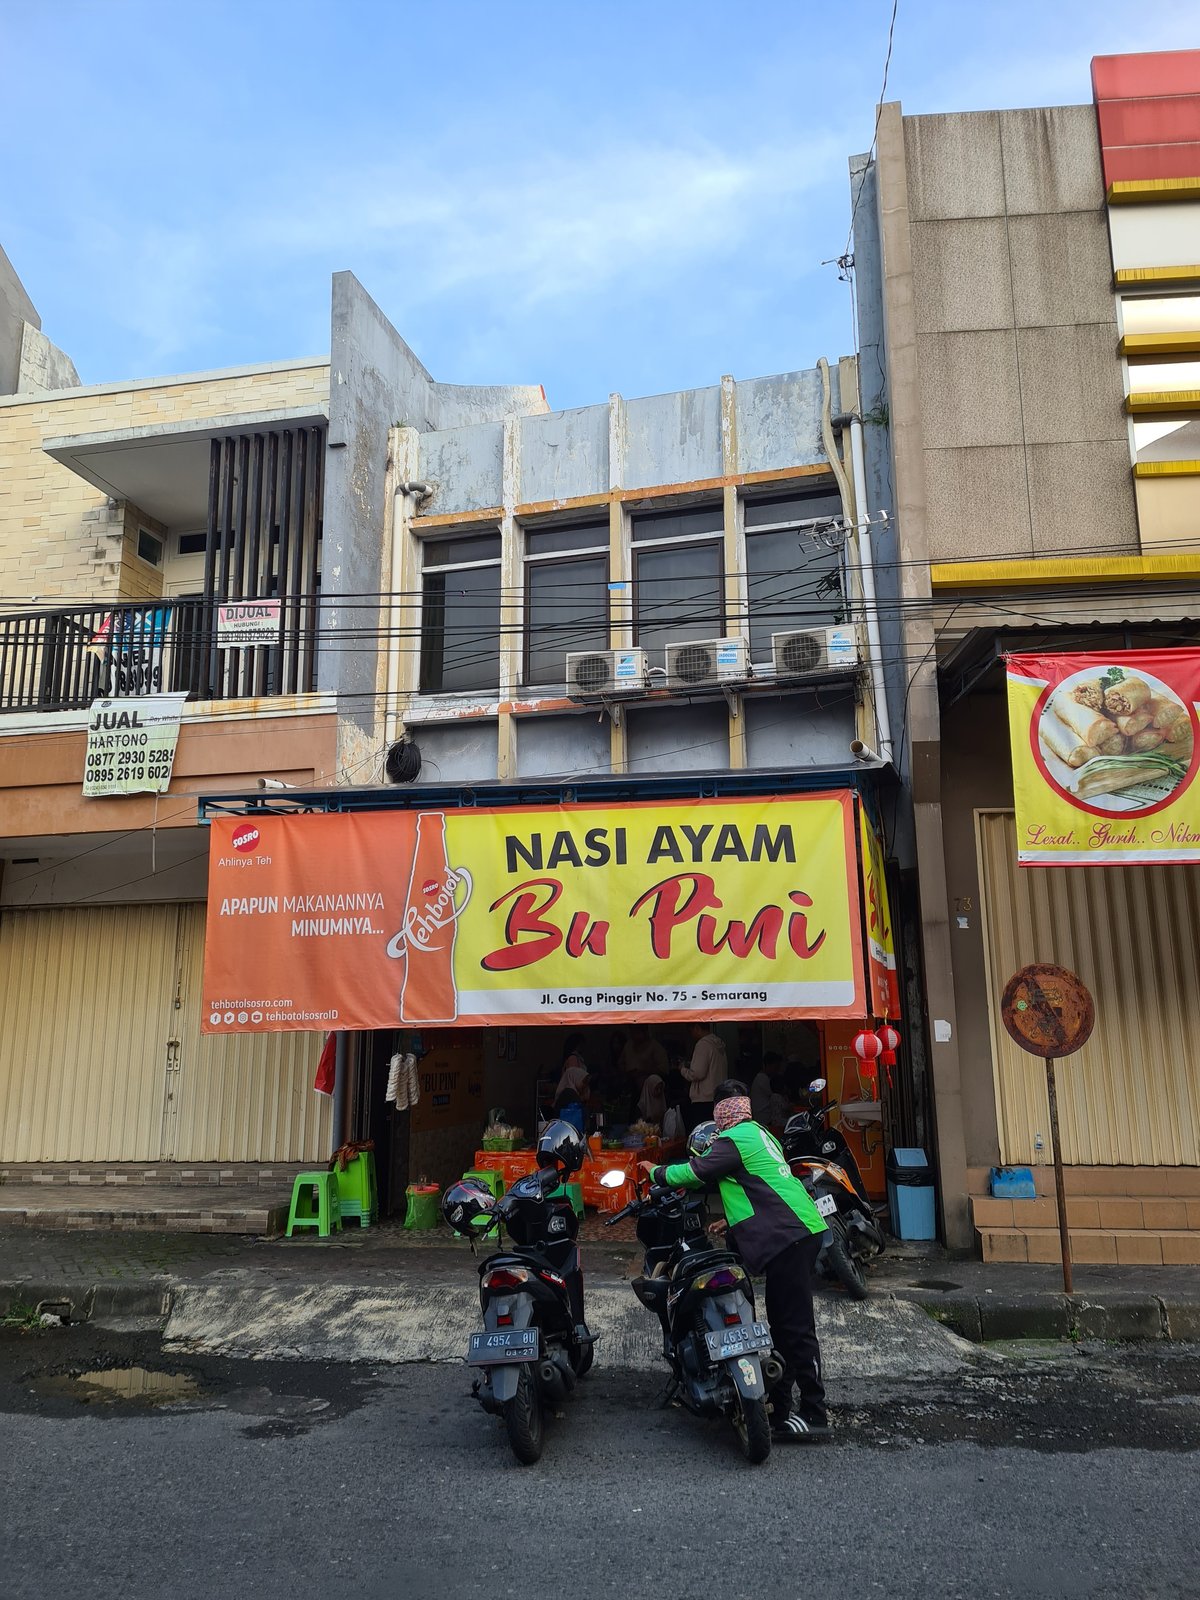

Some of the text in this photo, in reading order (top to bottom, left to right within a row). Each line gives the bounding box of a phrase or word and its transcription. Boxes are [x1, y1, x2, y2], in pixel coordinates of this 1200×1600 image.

[226, 606, 271, 620] DIJUAL
[90, 711, 143, 731] JUAL
[90, 733, 148, 749] HARTONO
[87, 752, 116, 767] 0877
[118, 750, 145, 765] 2930
[86, 765, 171, 783] 0895 2619 602
[232, 829, 259, 849] SOSRO
[505, 824, 797, 873] NASI AYAM
[218, 856, 272, 867] Ahlinya Teh
[422, 882, 439, 894] SOSRO
[220, 893, 385, 916] APAPUN MAKANANNYA
[386, 865, 473, 959] Tehbotol
[480, 877, 610, 972] Bu
[629, 872, 827, 960] Pini
[211, 998, 293, 1009] tehbotolsosro.com
[540, 993, 555, 1005] Jl.
[558, 992, 593, 1006] Gang
[596, 991, 642, 1006] Pinggir
[646, 990, 669, 1002] No.
[672, 990, 688, 1002] 75
[701, 988, 767, 1003] Semarang
[266, 1010, 338, 1021] tehbotolsosroID
[473, 1337, 480, 1349] H
[486, 1335, 511, 1347] 4954
[708, 1336, 717, 1349] K
[723, 1328, 749, 1344] 4635
[753, 1323, 768, 1337] GA
